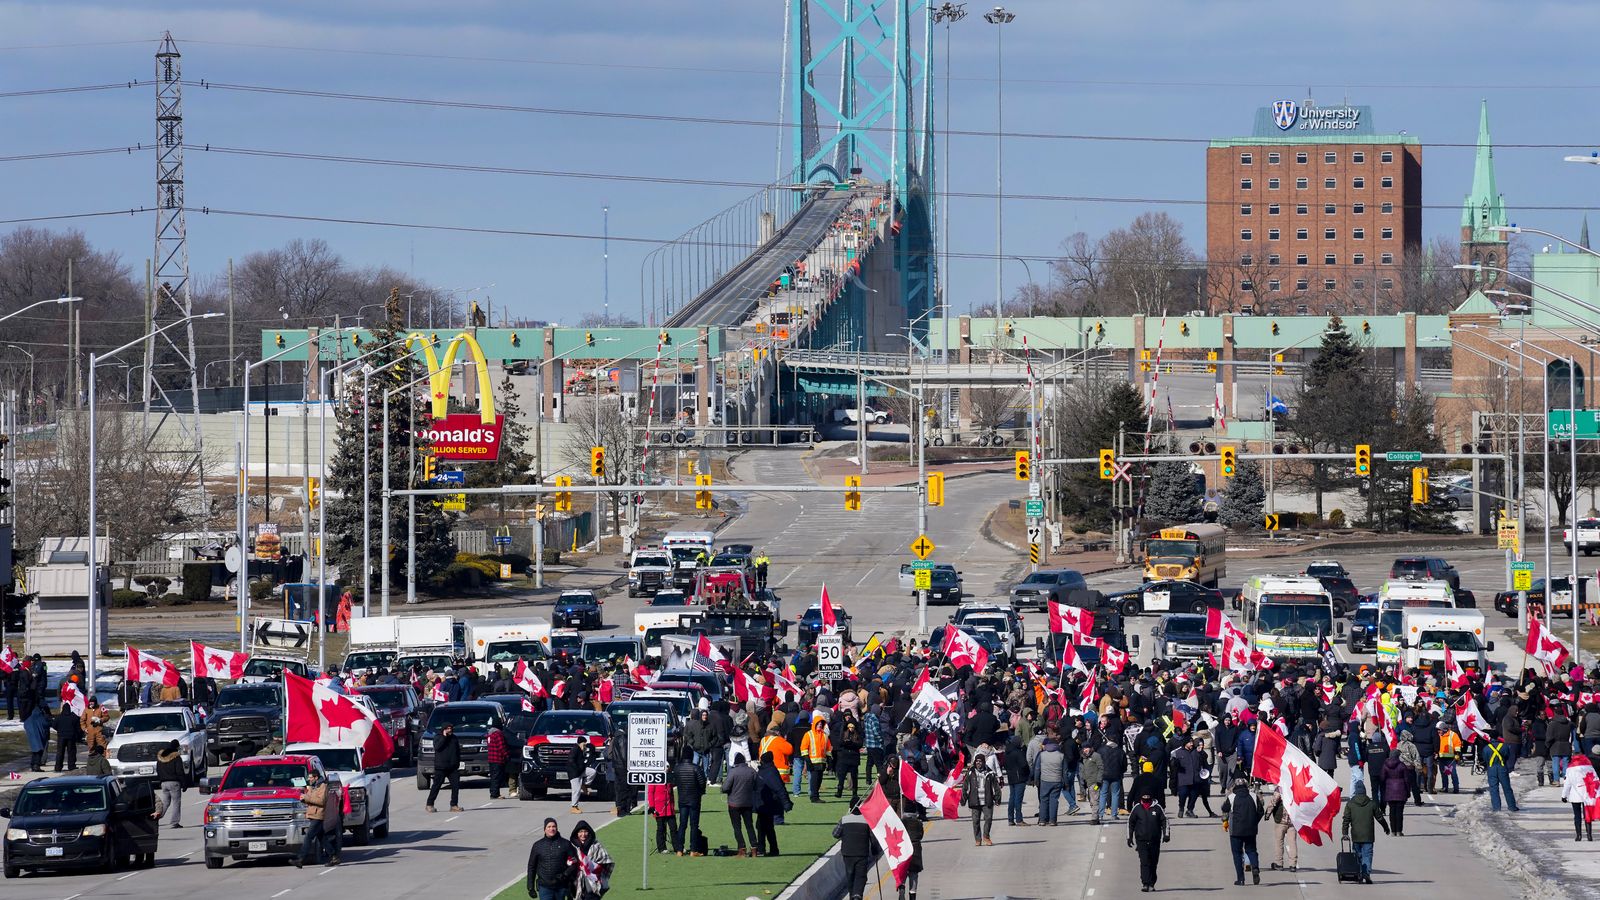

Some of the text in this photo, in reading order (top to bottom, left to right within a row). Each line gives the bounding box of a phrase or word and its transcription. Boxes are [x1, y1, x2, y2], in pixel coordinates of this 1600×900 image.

[1300, 107, 1358, 119] University
[1309, 119, 1359, 129] Windsor
[1388, 453, 1413, 461] College
[821, 646, 839, 659] 50
[631, 774, 662, 783] ENDS
